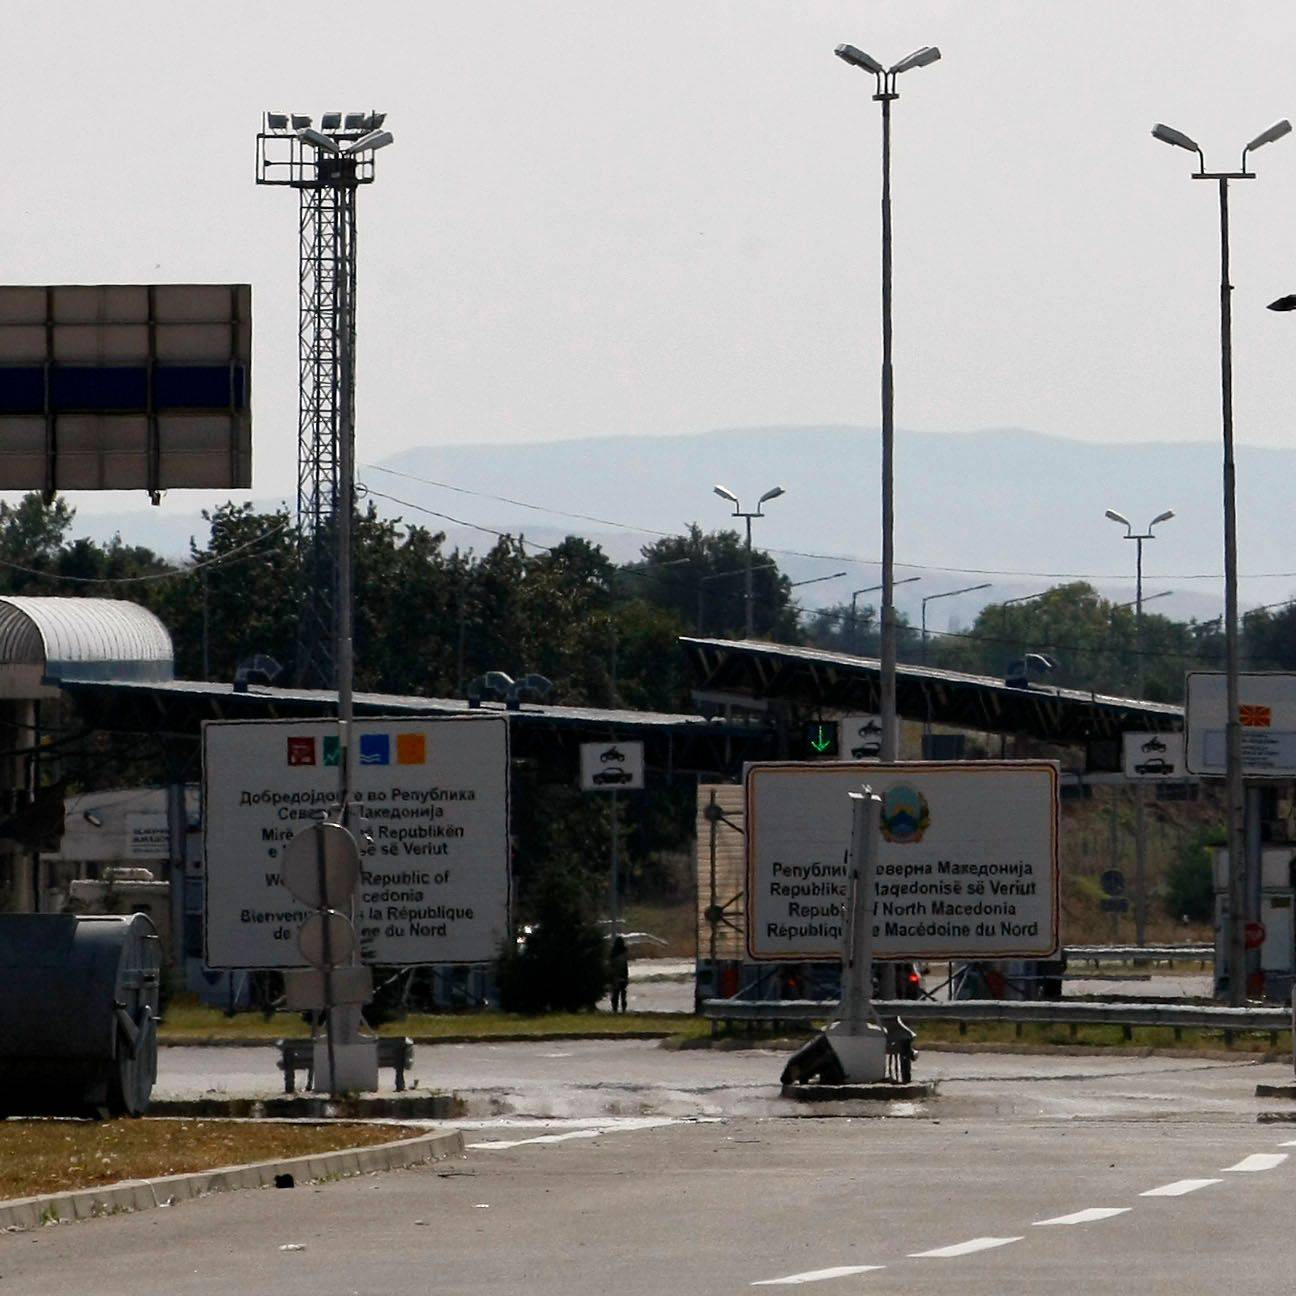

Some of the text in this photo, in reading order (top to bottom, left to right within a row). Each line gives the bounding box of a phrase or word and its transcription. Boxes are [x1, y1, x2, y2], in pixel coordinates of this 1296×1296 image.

[367, 791, 386, 801] во
[391, 787, 475, 804] Република
[378, 824, 464, 841] Republikën
[403, 843, 448, 856] Veriut
[937, 861, 1033, 878] Македонија
[361, 870, 450, 888] Republic of
[875, 880, 962, 897] aqedonisë
[967, 880, 985, 895] së
[989, 880, 1036, 895] Veriut
[369, 907, 383, 920] la
[387, 906, 474, 922] République
[883, 902, 926, 916] North
[931, 902, 1016, 916] Macedonia
[273, 926, 290, 940] de
[385, 925, 405, 937] du
[409, 923, 447, 937] Nord
[885, 922, 970, 937] Macédoine
[975, 922, 995, 937] du
[1001, 922, 1038, 936] Nord
